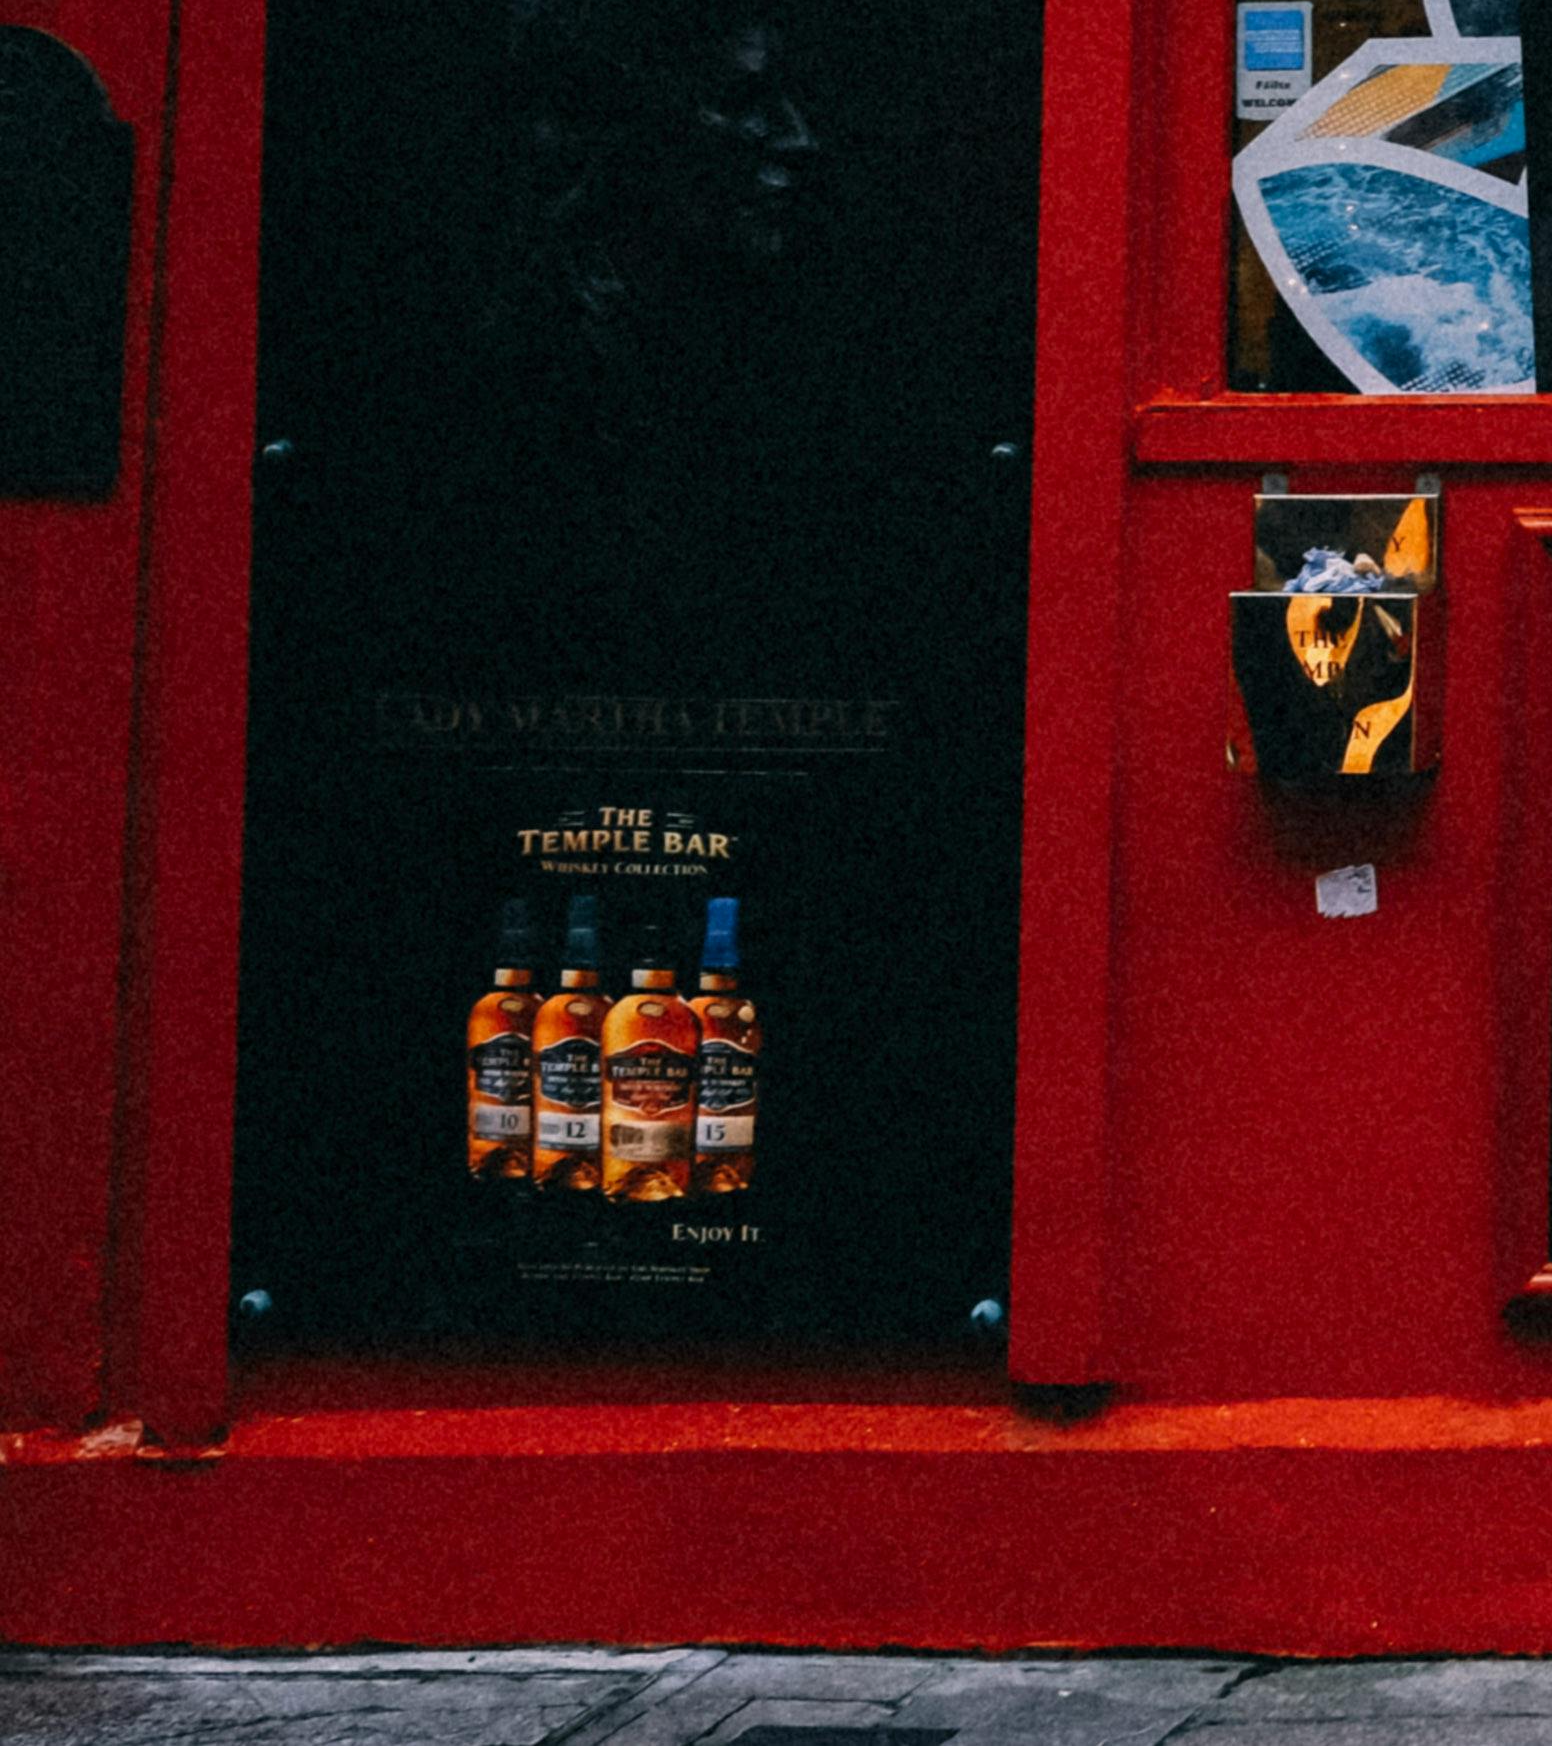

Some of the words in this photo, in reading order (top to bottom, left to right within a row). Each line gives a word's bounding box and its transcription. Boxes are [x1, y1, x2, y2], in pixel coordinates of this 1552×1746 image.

[600, 806, 653, 827] THE
[517, 829, 651, 855] TEMPLE
[663, 831, 730, 858] BAR
[499, 1114, 518, 1129] 10
[566, 1123, 585, 1138] 12
[705, 1124, 725, 1140] 15
[672, 1223, 733, 1242] ENJOY
